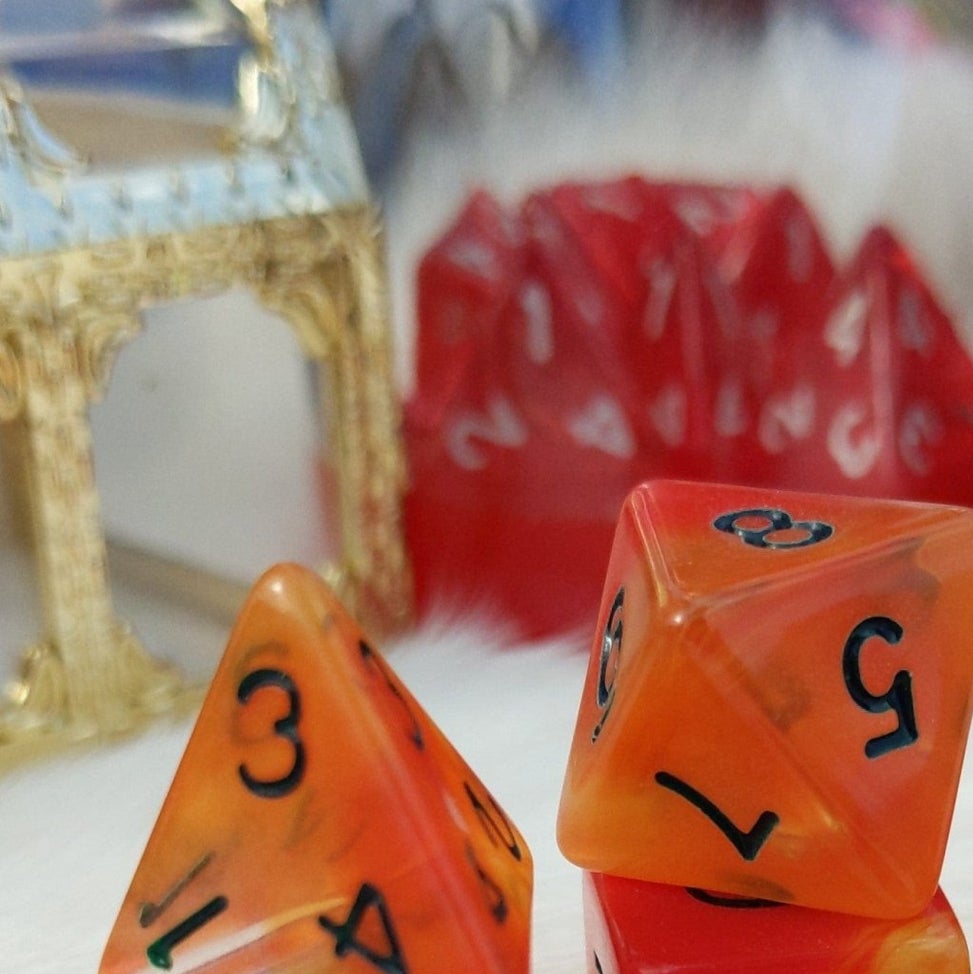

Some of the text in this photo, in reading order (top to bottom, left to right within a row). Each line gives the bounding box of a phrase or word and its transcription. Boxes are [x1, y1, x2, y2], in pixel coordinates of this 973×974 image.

[711, 508, 834, 549] 8
[237, 668, 306, 799] 3
[842, 616, 918, 759] 5
